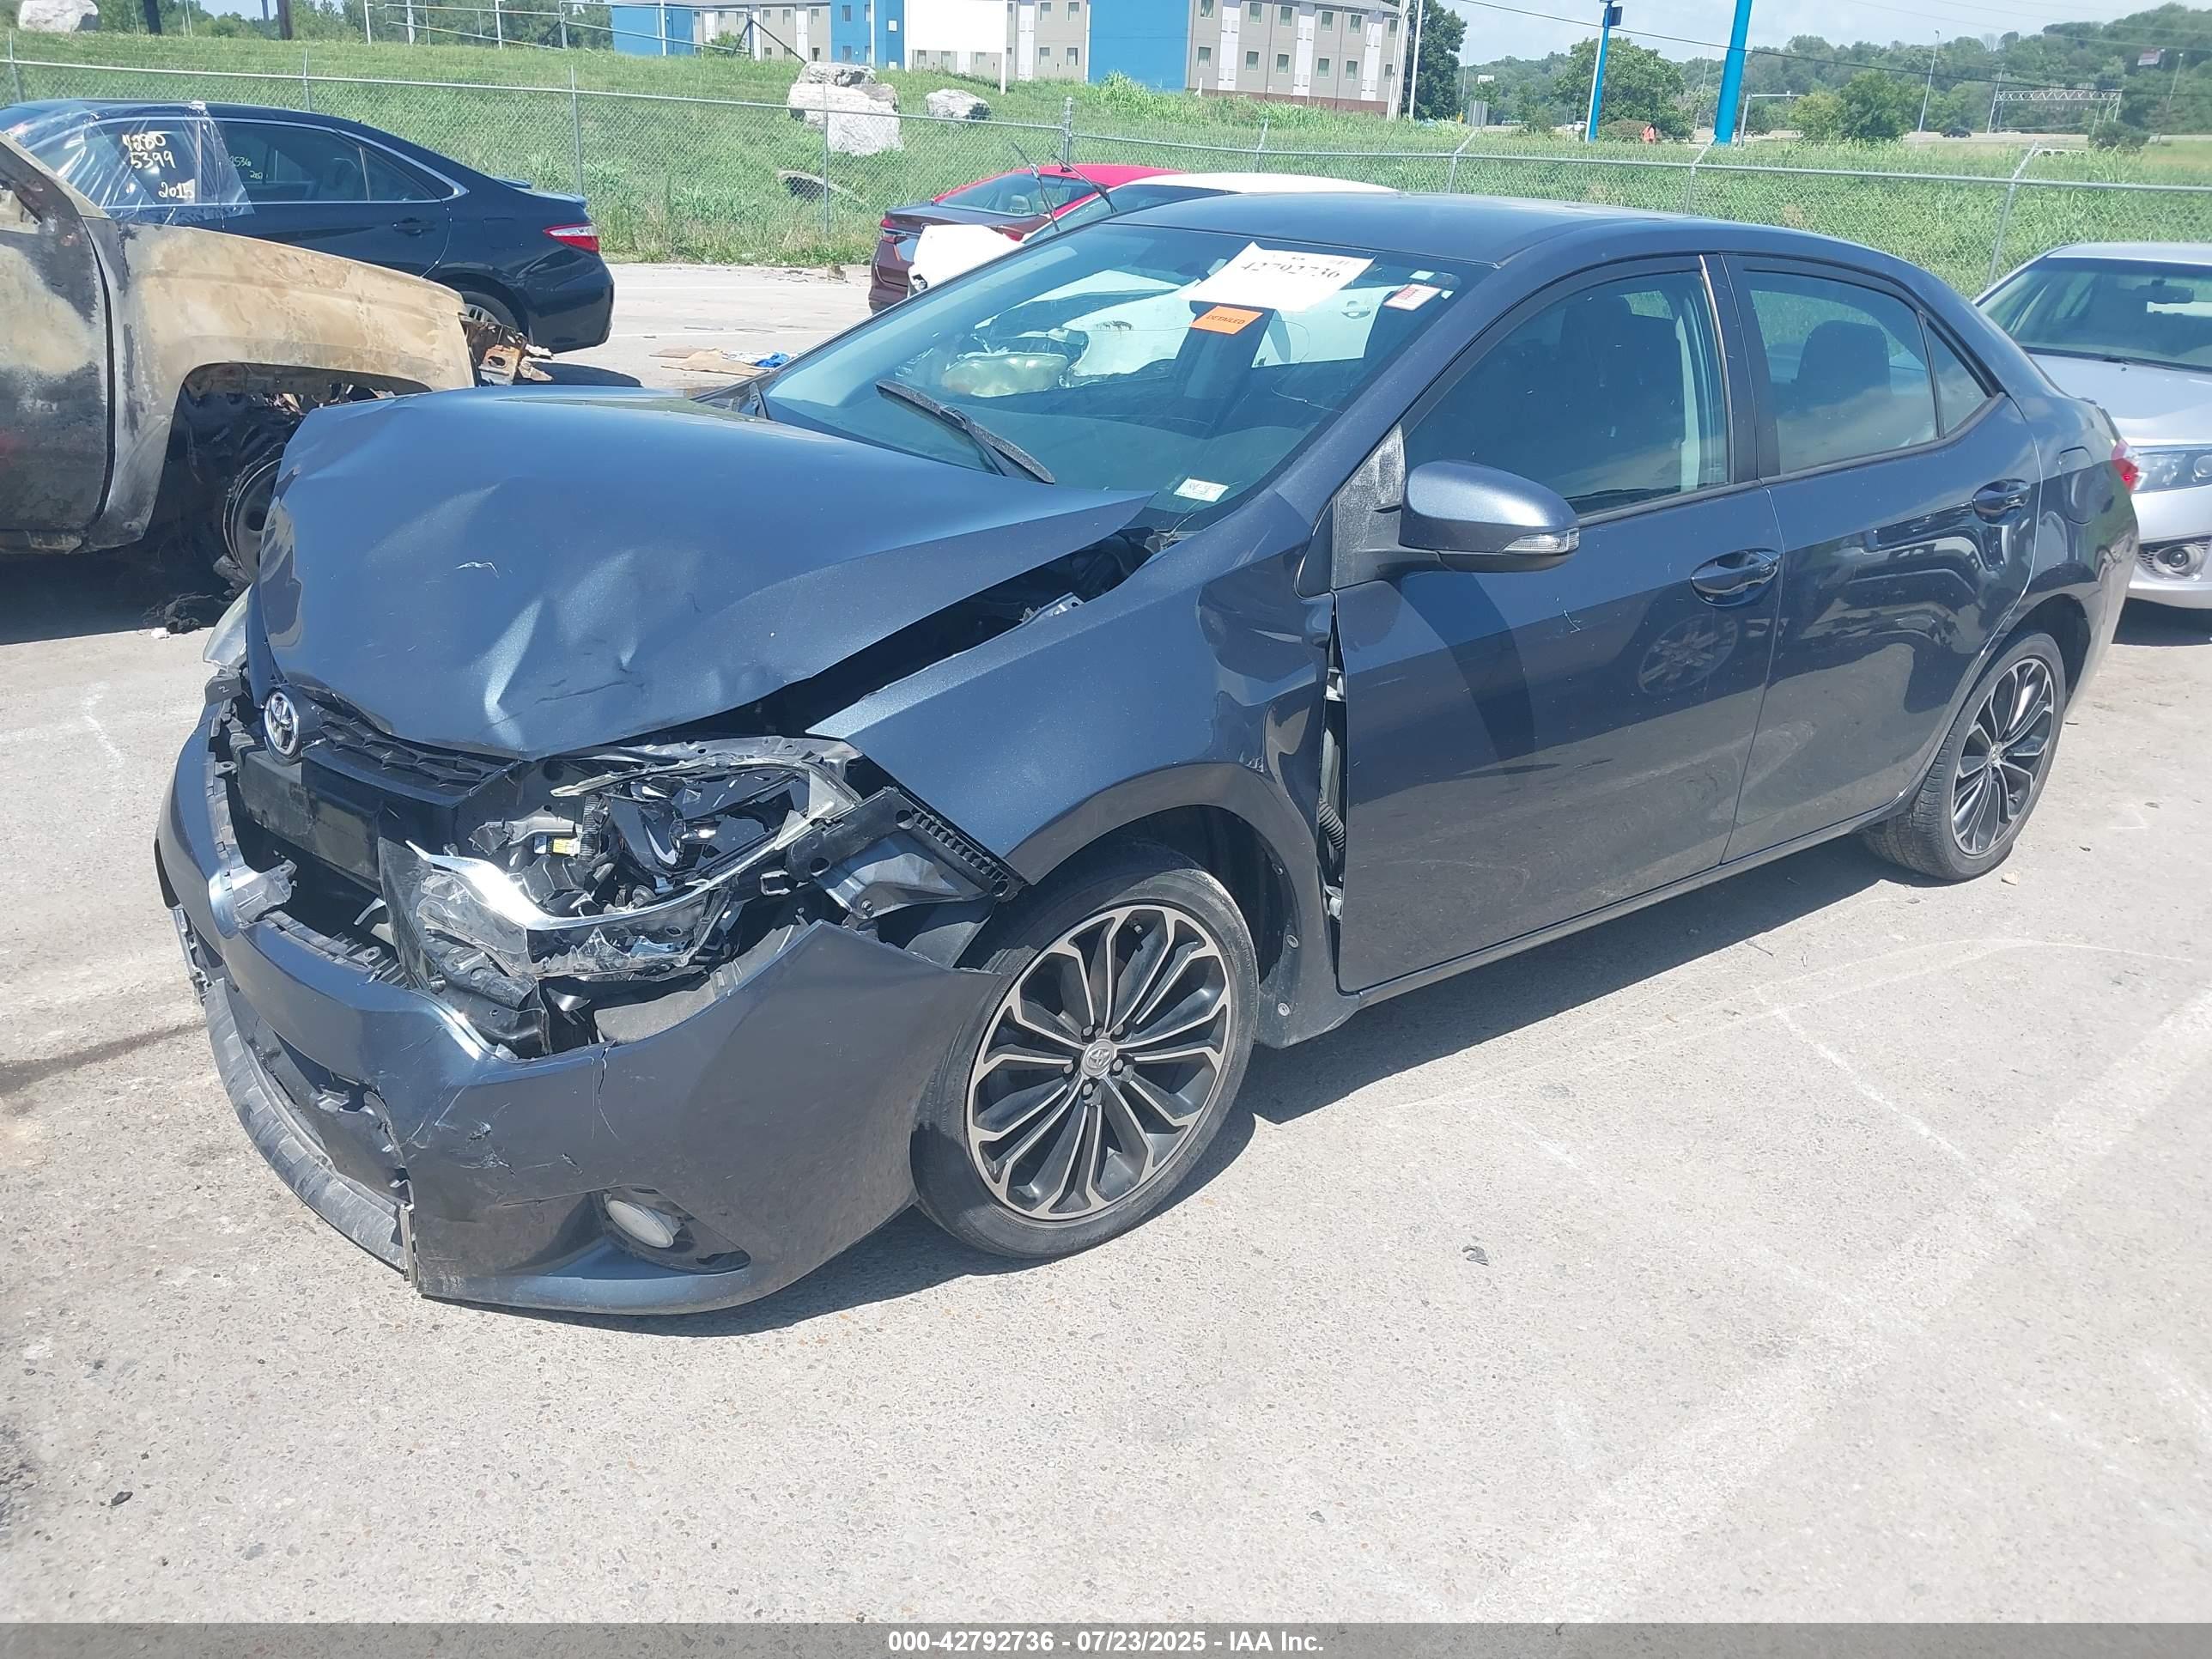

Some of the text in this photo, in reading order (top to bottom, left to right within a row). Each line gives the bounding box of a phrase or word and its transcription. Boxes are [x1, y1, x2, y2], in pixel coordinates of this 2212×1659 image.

[122, 133, 167, 152] 4280
[130, 150, 177, 169] 5399
[158, 181, 195, 199] 2015
[1205, 313, 1246, 325] DETAILED
